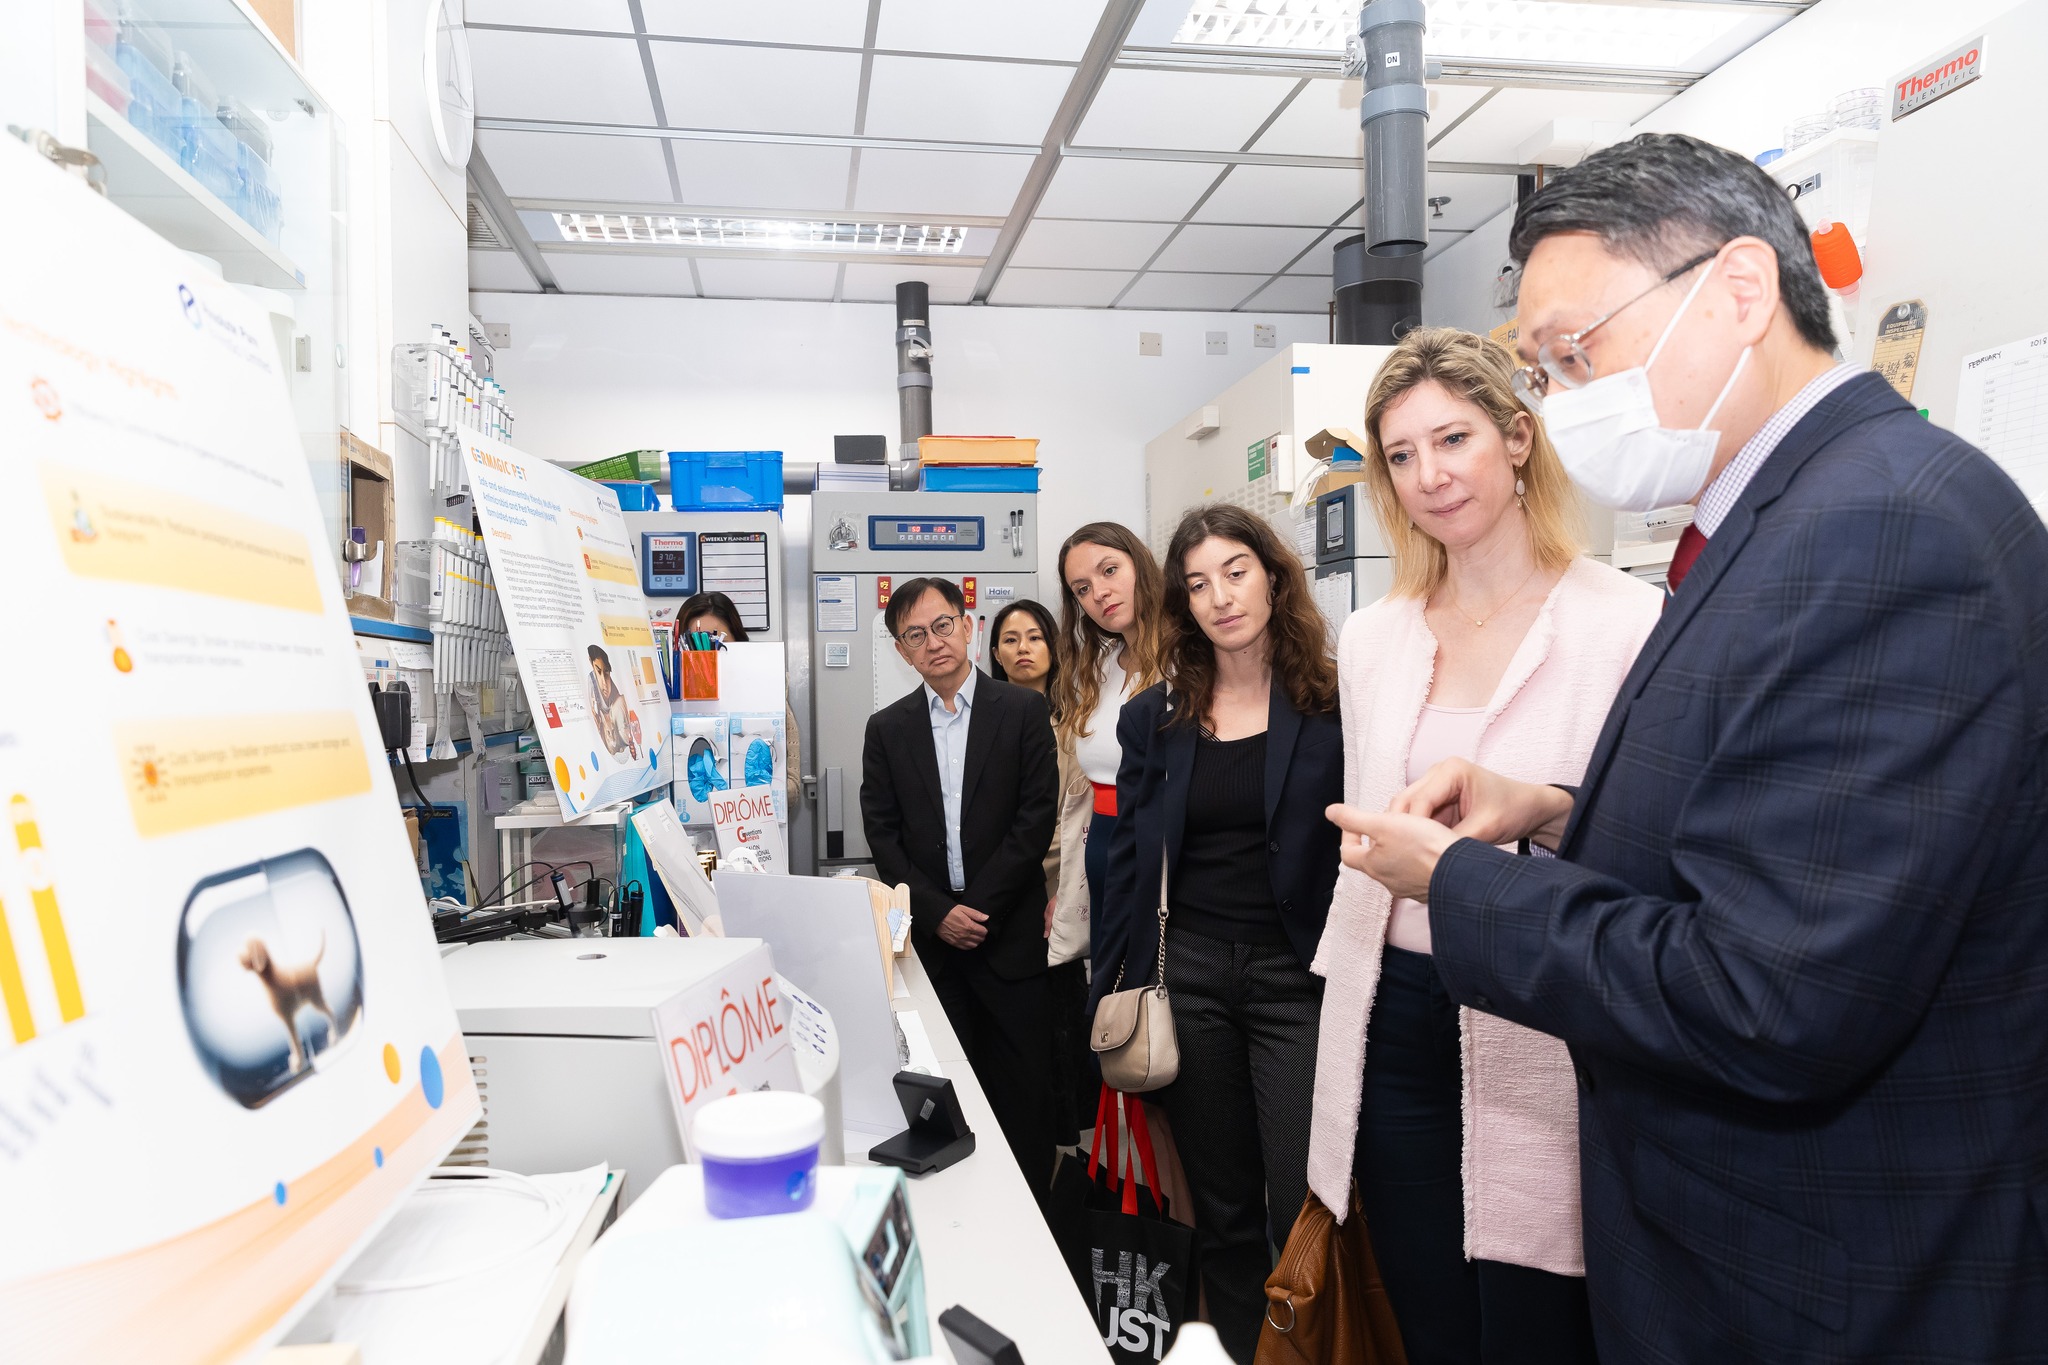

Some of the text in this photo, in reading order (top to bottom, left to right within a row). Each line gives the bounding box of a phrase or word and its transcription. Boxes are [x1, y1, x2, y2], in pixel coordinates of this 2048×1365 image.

[1386, 54, 1398, 64] ON
[1897, 48, 1979, 102] Thermo
[1898, 66, 1976, 112] SCIENTIFIC
[1968, 336, 2048, 370] FEBRUARY 2018
[470, 447, 527, 482] GERMAGIC PET
[988, 588, 1011, 596] Haier
[714, 793, 774, 826] DIPLÔME
[670, 976, 783, 1104] DIPLÔME
[1092, 1248, 1171, 1322] HK
